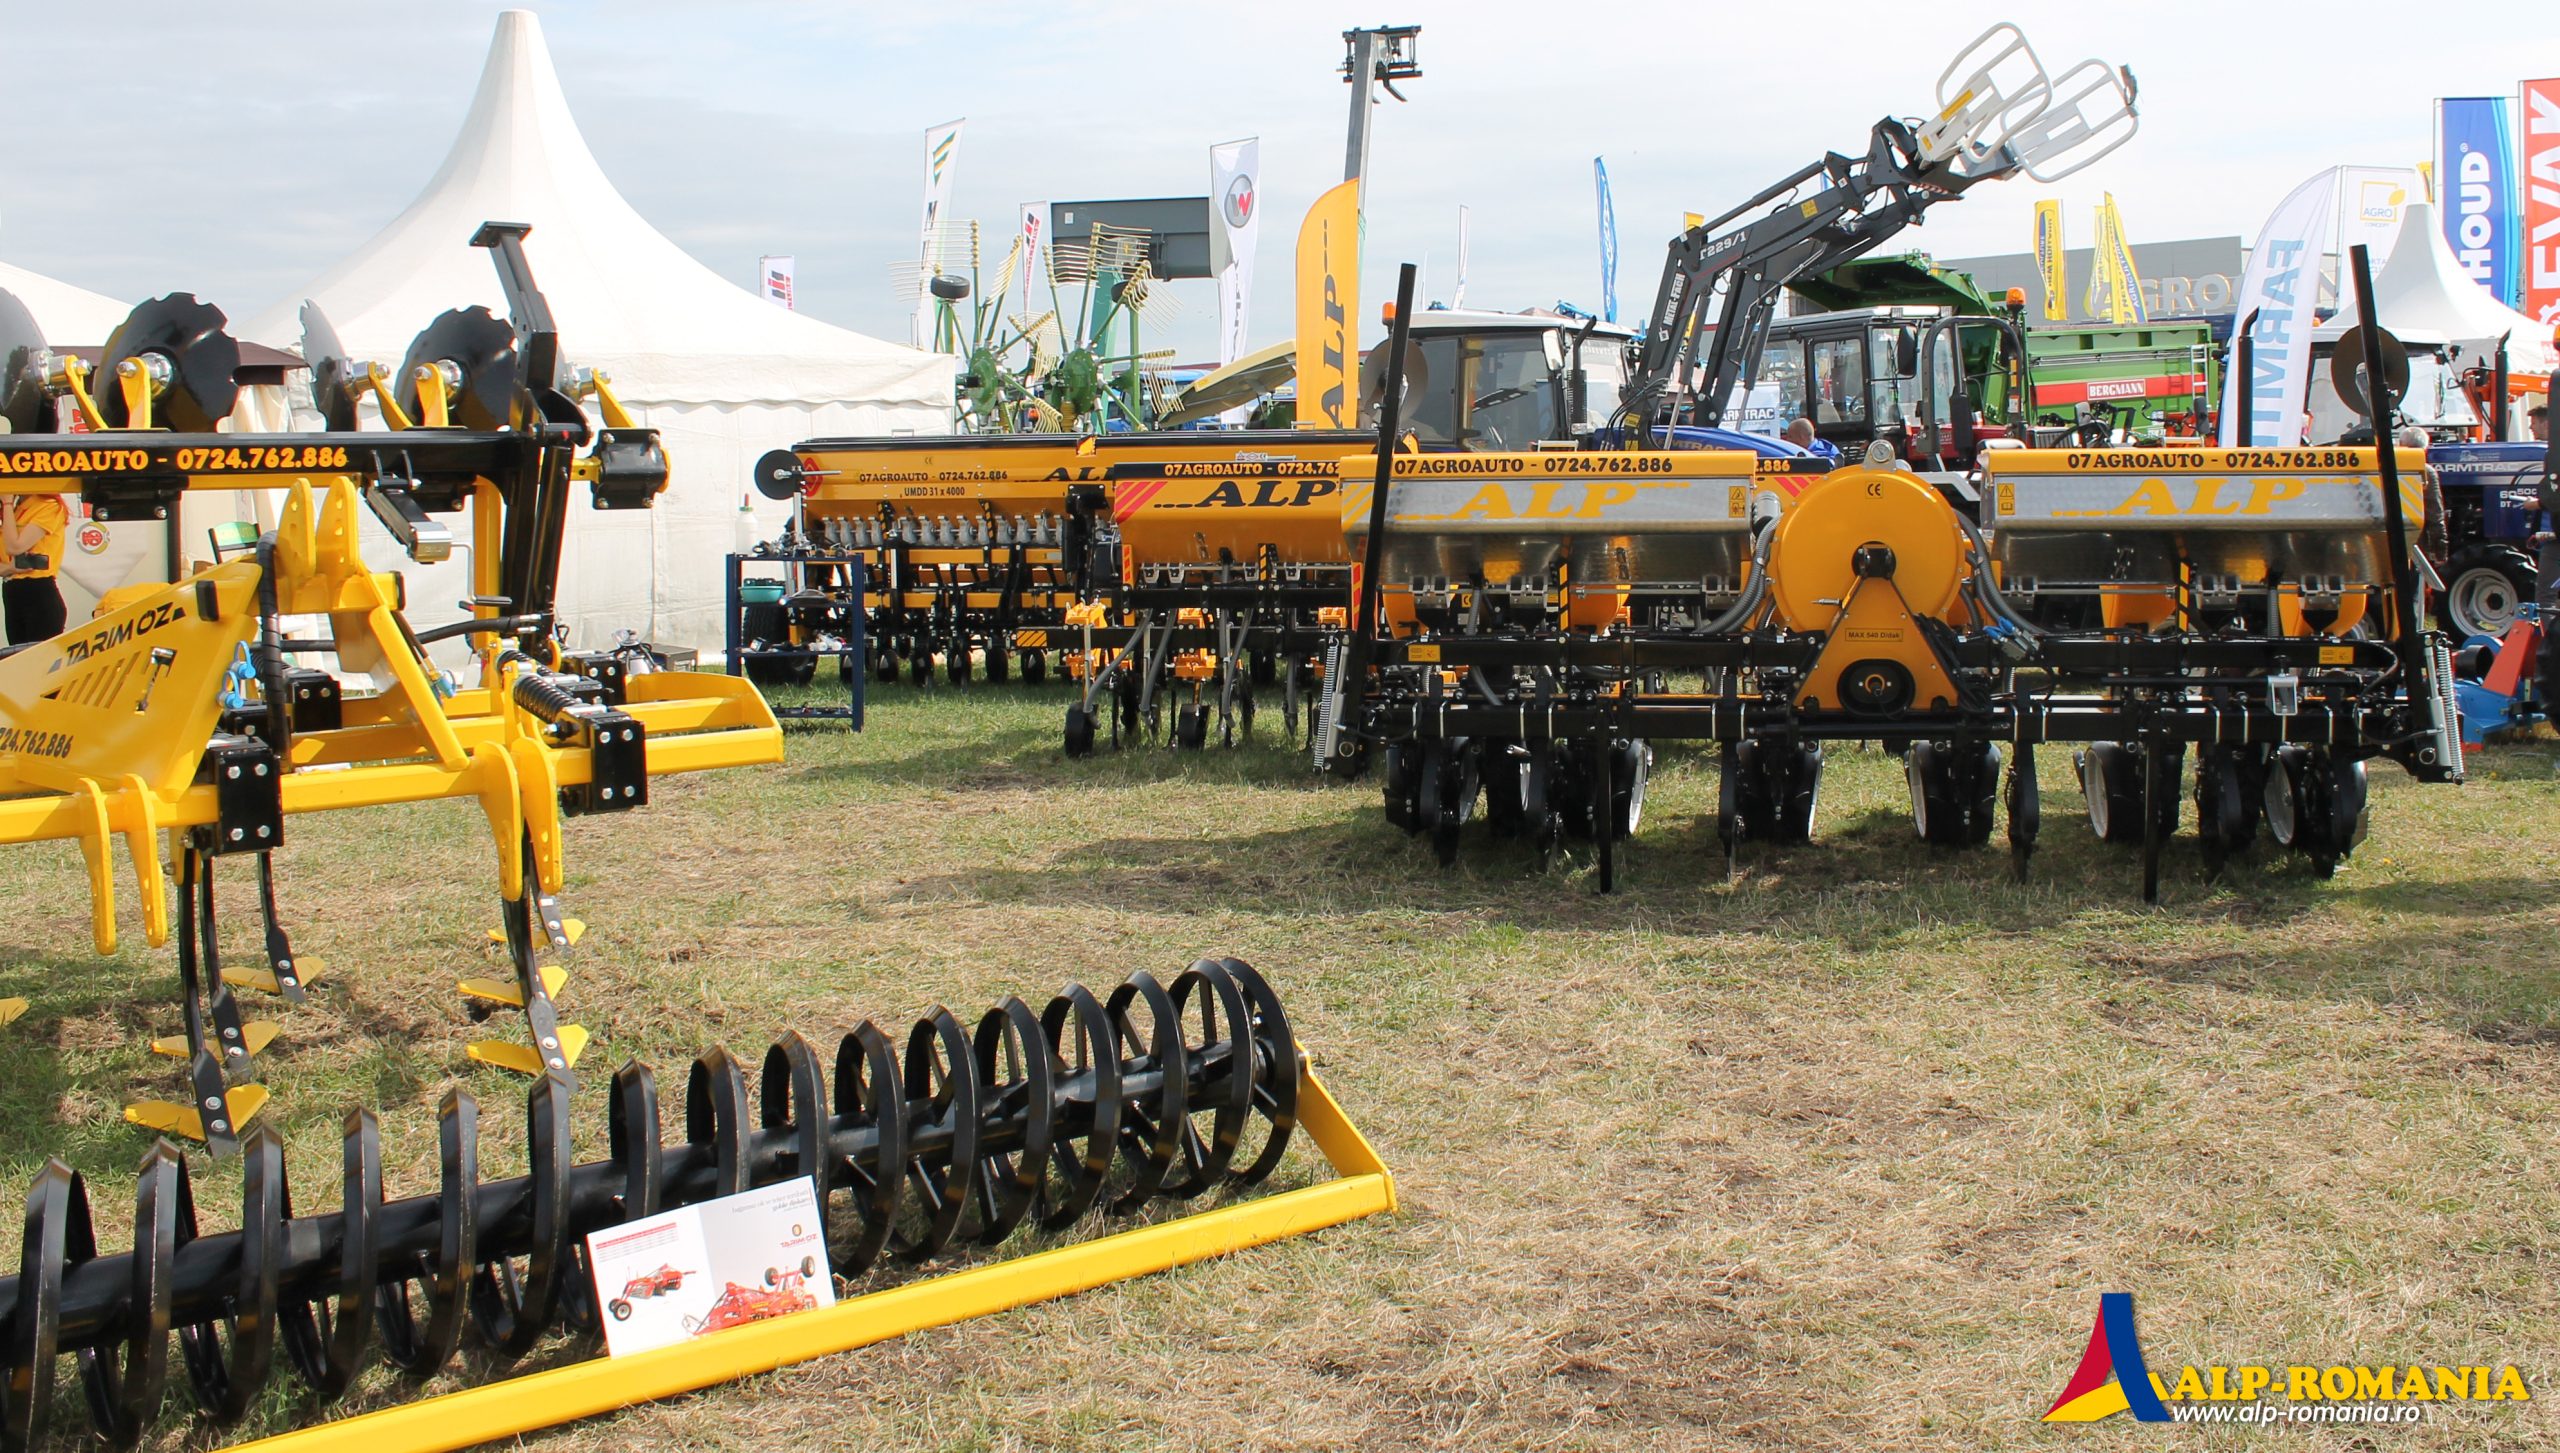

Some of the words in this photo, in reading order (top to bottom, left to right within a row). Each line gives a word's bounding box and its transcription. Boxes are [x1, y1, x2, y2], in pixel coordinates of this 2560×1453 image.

[2363, 207, 2393, 218] AGRO
[2460, 152, 2492, 296] HOUD
[2089, 382, 2144, 397] BERGMANN
[0, 450, 148, 473] AGROAUTO
[176, 446, 347, 470] 0724.762.886
[1394, 459, 1524, 474] 07AGROAUTO
[1544, 457, 1673, 473] 0724.762.886
[2067, 453, 2204, 469] 07AGROAUTO
[2226, 452, 2360, 469] 0724.762.886
[2434, 462, 2519, 473] ARMTRAC
[860, 472, 928, 483] 07AGROAUTO
[939, 471, 1008, 481] 0724.762.886
[1164, 463, 1262, 476] 07AGROAUTO
[904, 487, 928, 497] UMDD
[929, 487, 939, 496] 31
[946, 486, 965, 496] 4000
[2108, 477, 2307, 516] ALP
[1442, 482, 1638, 519] ALP
[67, 618, 134, 667] TARIM
